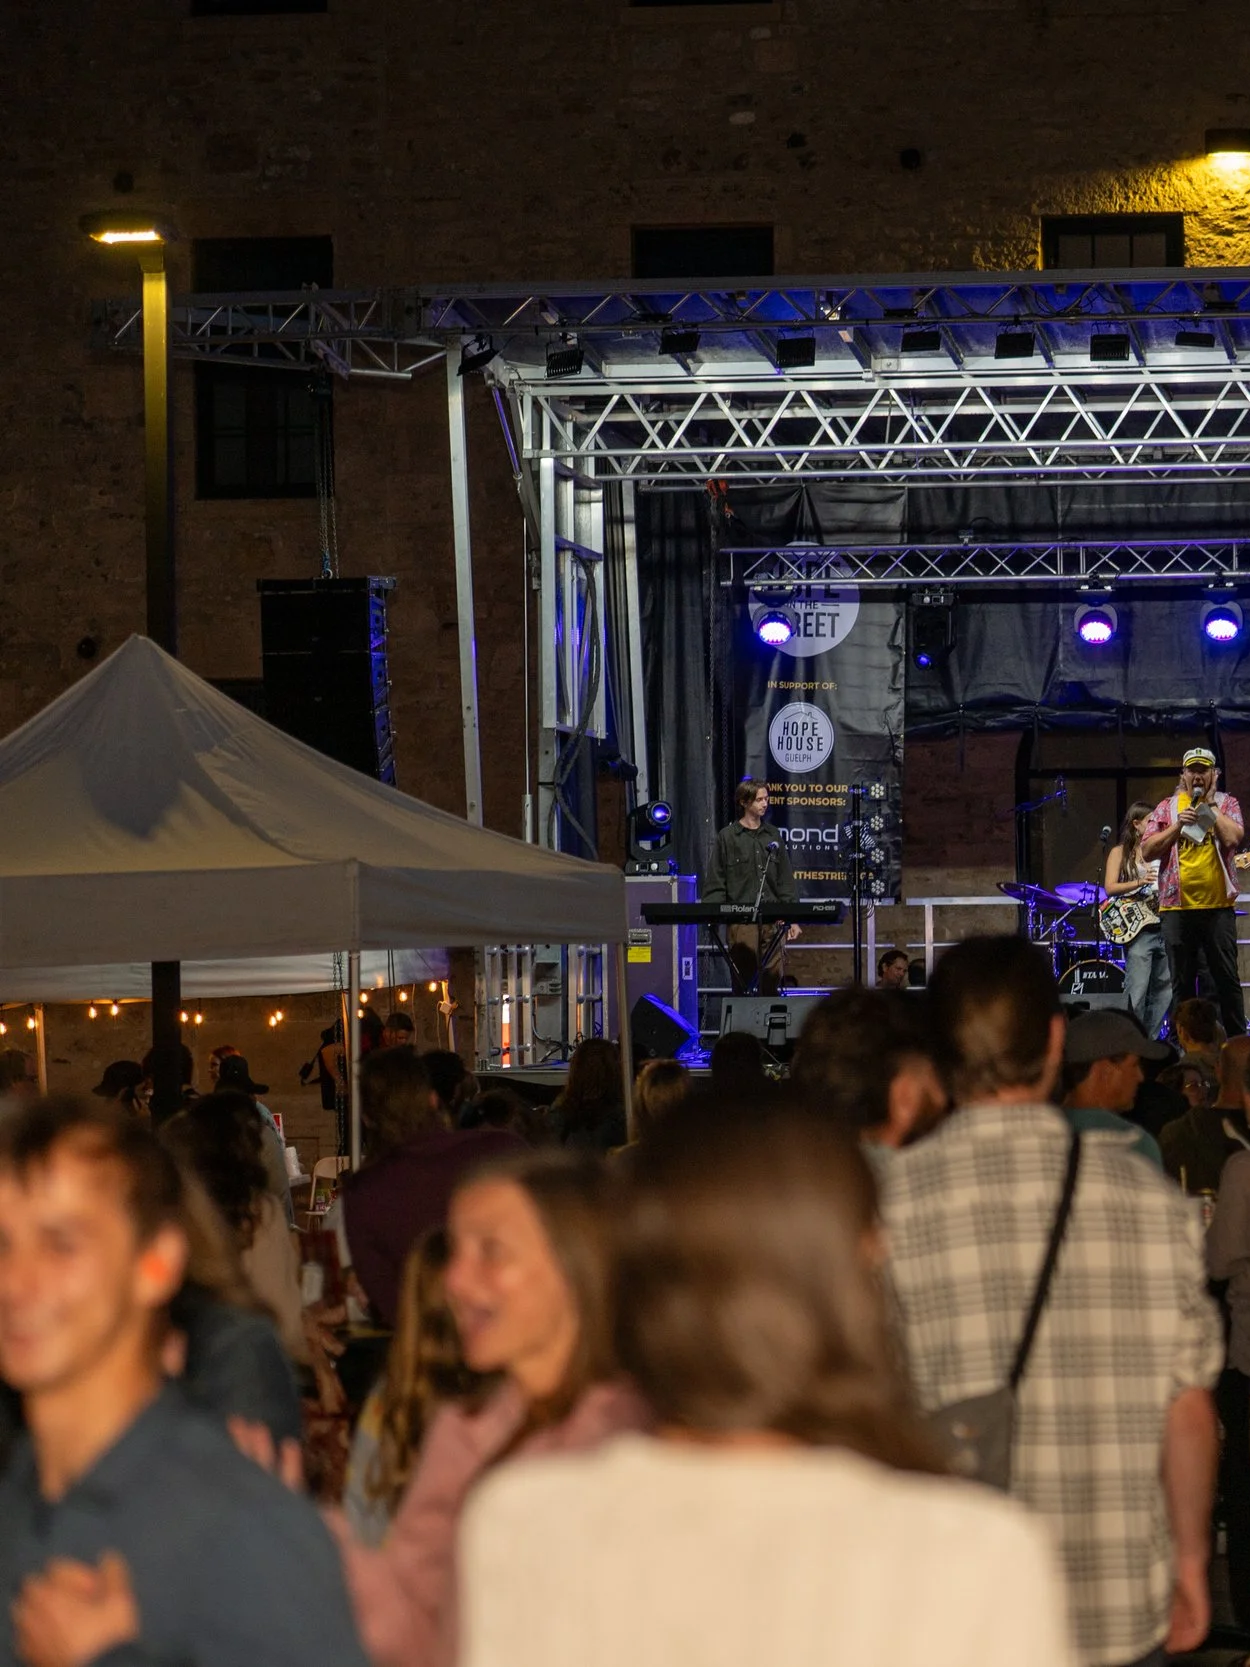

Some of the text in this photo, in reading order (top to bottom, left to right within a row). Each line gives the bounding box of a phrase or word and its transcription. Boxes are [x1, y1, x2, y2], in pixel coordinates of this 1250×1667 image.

[798, 600, 819, 609] THE
[767, 680, 838, 690] IN SUPPORT OF:
[783, 721, 818, 736] HOPE
[777, 736, 823, 751] HOUSE
[785, 753, 812, 763] GUELPH
[784, 783, 807, 793] YOU
[809, 784, 823, 793] TO
[826, 784, 849, 793] OUR
[768, 797, 847, 807] ENT SPONSORS:
